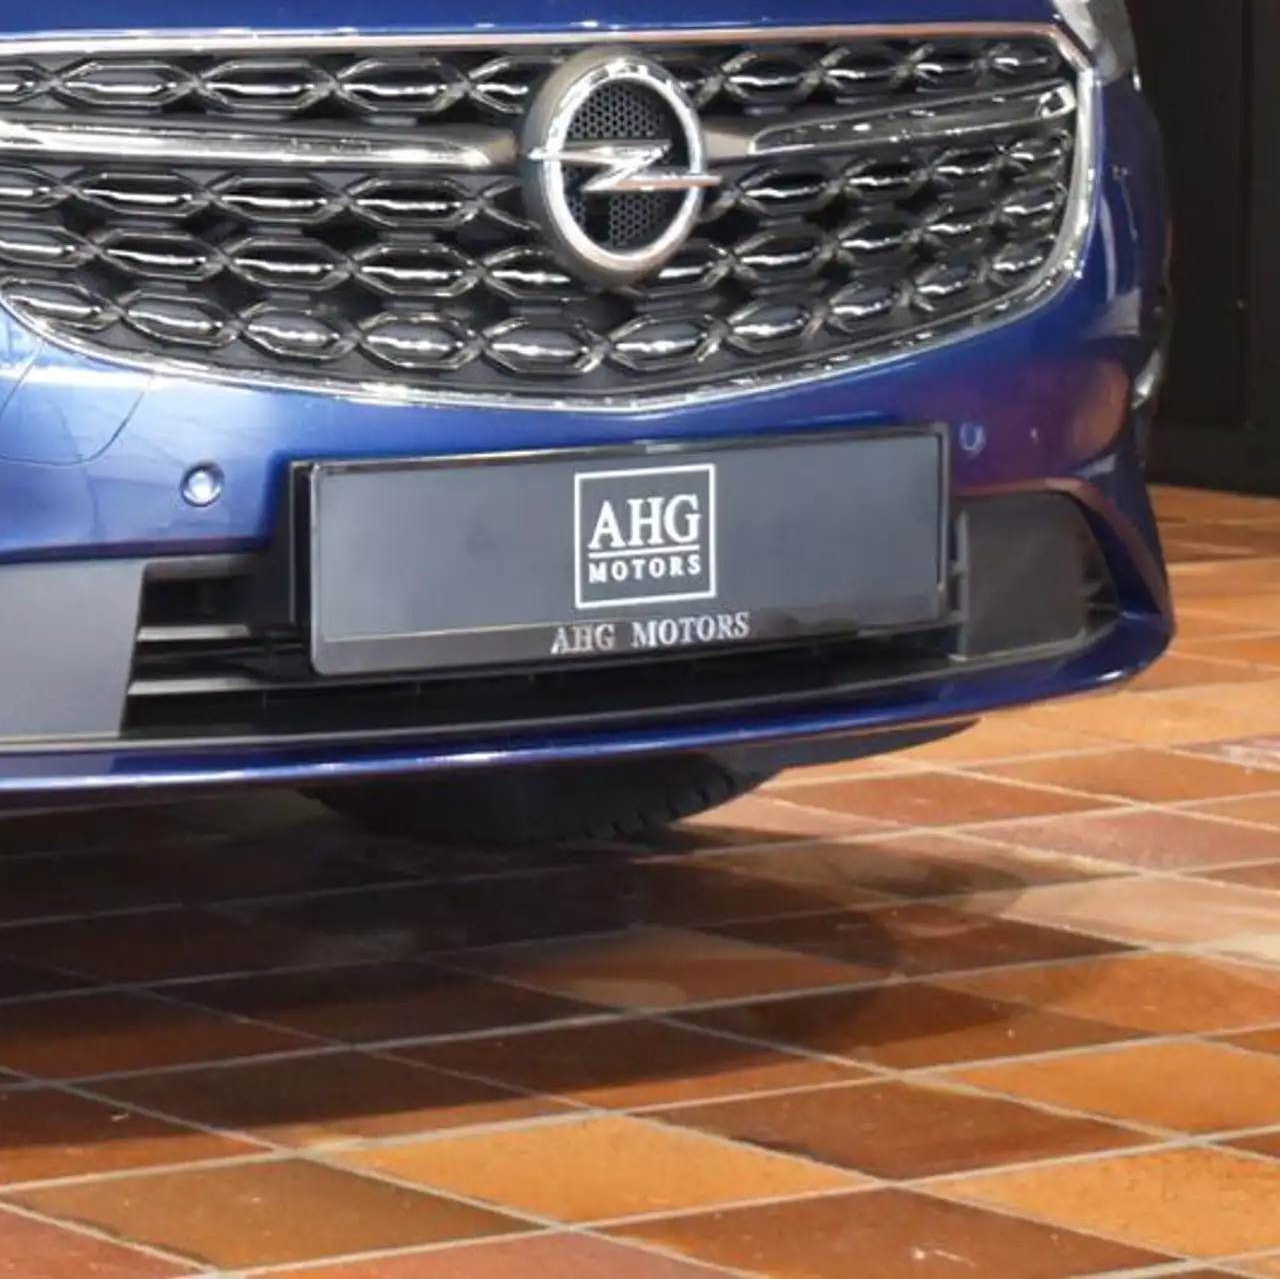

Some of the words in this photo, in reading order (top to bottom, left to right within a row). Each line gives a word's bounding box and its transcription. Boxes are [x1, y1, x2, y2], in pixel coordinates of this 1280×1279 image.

[587, 494, 703, 550] AHG
[588, 554, 702, 584] MOTORS
[550, 623, 616, 655] AHG
[631, 611, 751, 649] MOTORS
